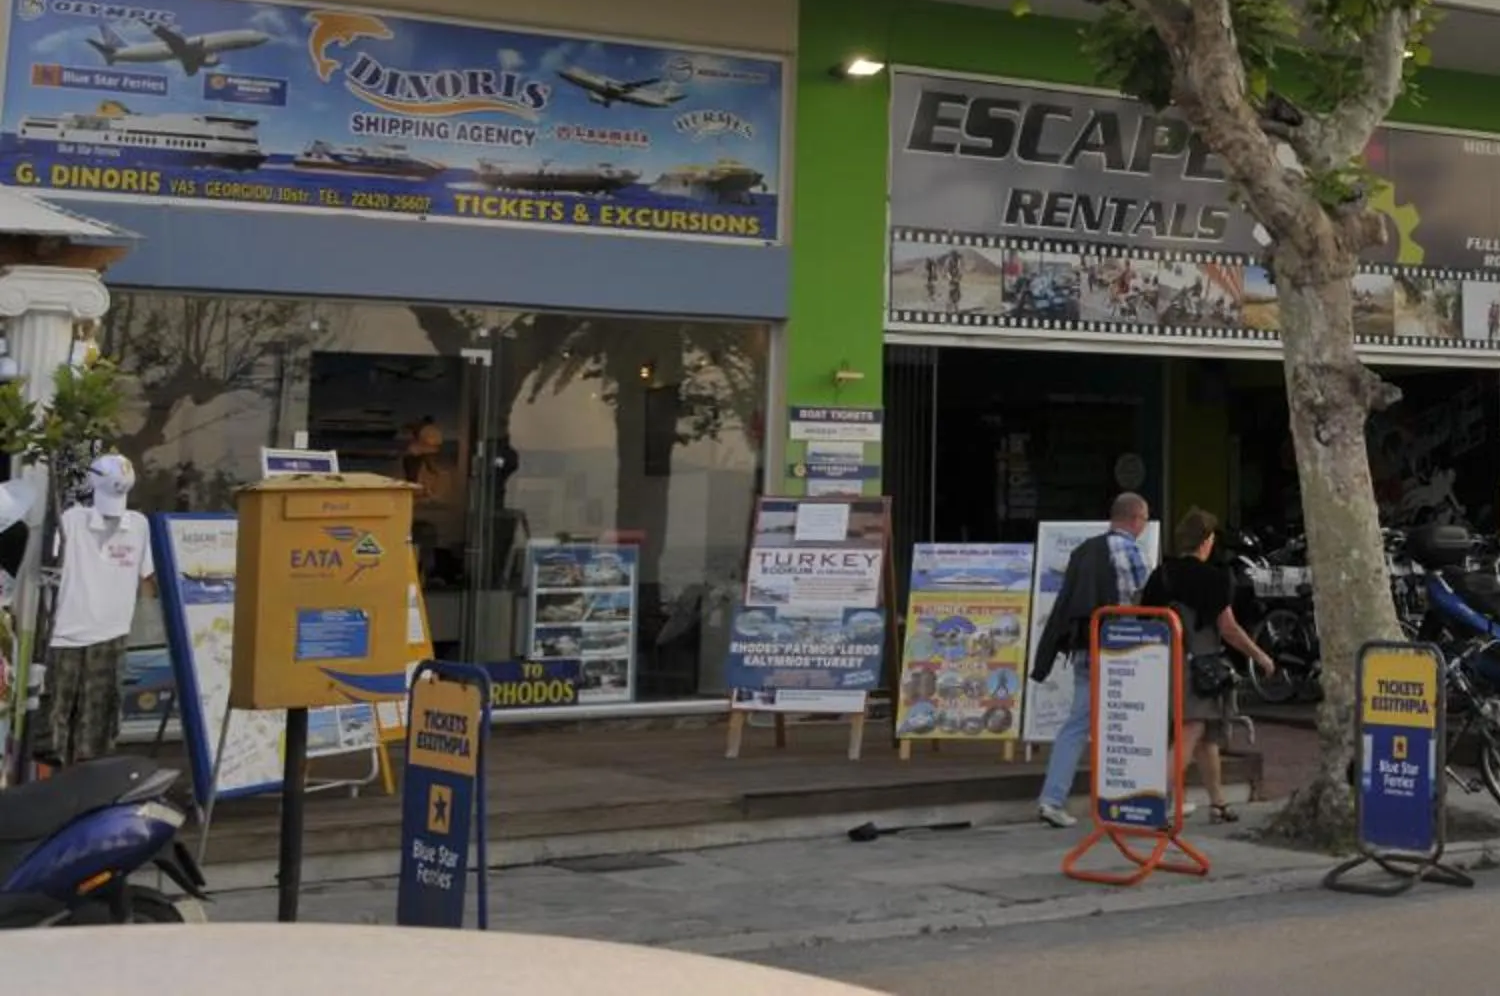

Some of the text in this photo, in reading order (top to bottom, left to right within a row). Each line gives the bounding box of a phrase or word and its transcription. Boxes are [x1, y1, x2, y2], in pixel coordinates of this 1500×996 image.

[53, 0, 177, 24] OLYMPIC
[62, 70, 166, 92] Blue Star Ferries
[349, 52, 550, 109] DINORIS
[351, 114, 536, 146] SHIPPING AGENCY
[16, 163, 41, 184] G.
[51, 164, 161, 193] DINORIS
[453, 193, 761, 236] TICKETS & EXCURSIONS
[1003, 187, 1229, 243] RENTALS
[1466, 237, 1500, 252] FULL
[799, 409, 874, 421] BOAT TICKETS
[756, 552, 879, 568] TURKEY
[522, 663, 543, 678] TO
[490, 679, 575, 705] RHODOS
[1377, 679, 1425, 697] TICKETS
[413, 838, 459, 868] Blue Star
